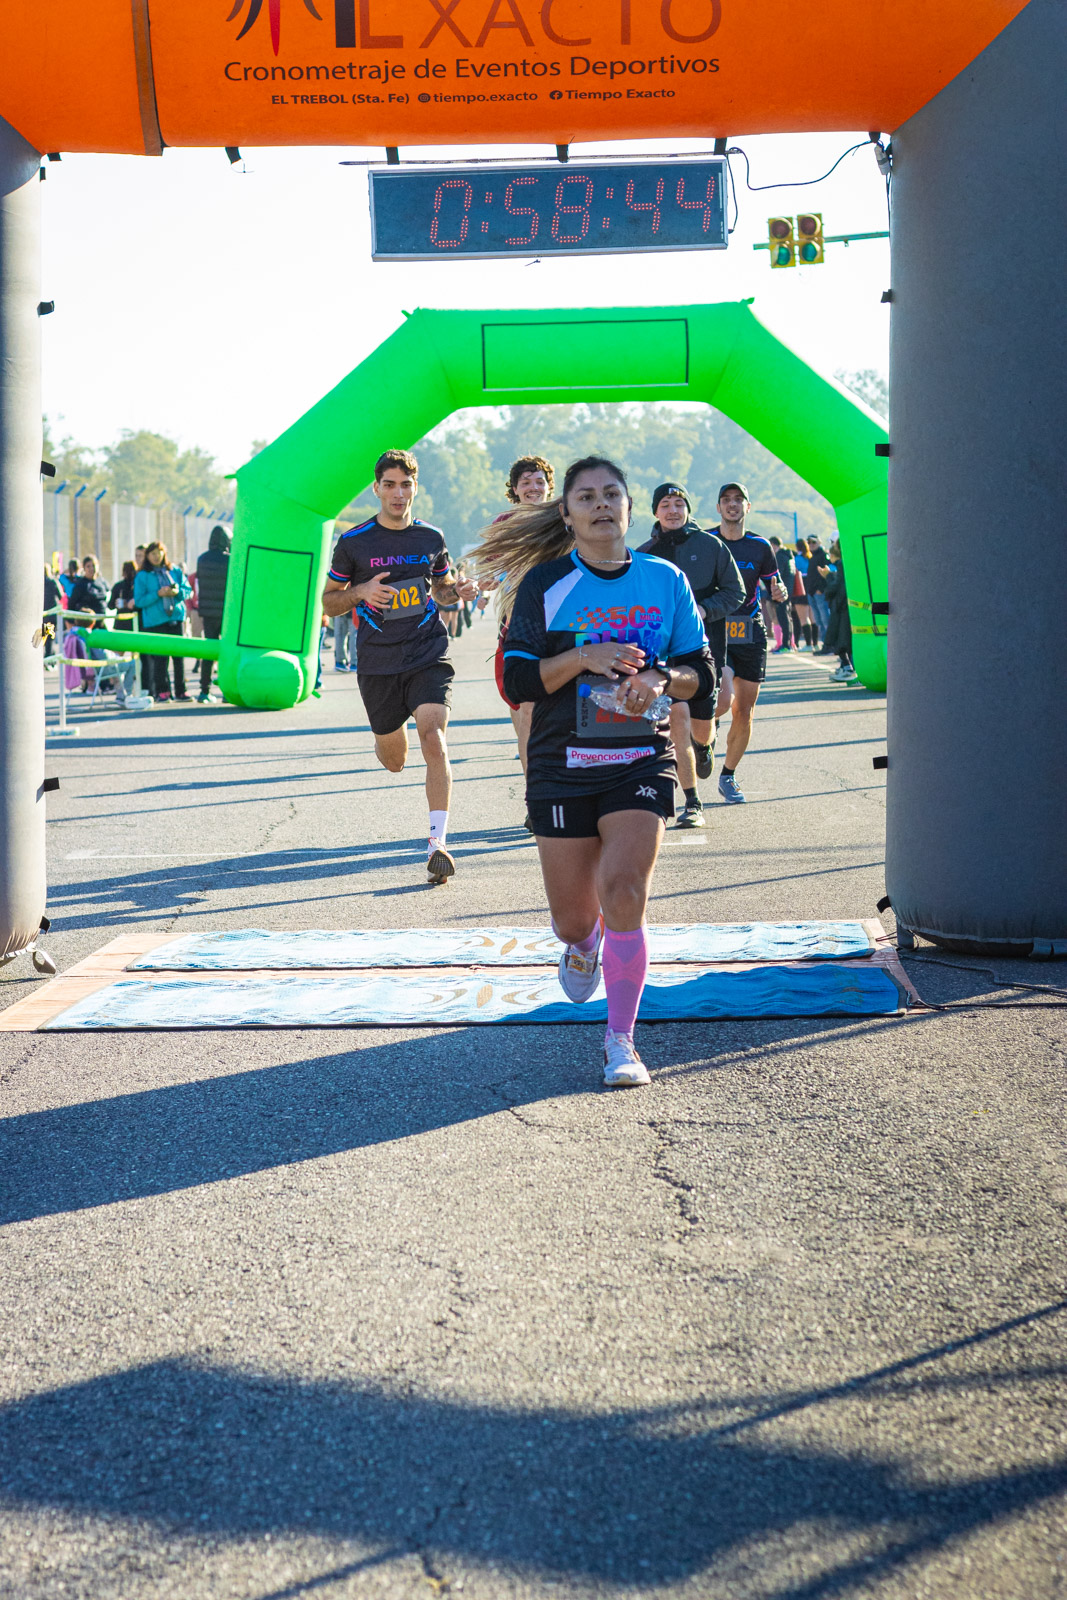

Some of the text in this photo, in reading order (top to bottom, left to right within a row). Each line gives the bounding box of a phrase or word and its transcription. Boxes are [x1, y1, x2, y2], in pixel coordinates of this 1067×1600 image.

[224, 55, 720, 84] Cronometraje de Eventos Deportivos
[271, 88, 676, 105] EL TREBOL (Sta. Fe) tiempo.exacto Tiempo Exacto
[430, 175, 716, 248] 0:58:44
[370, 554, 430, 568] RUNNEA
[571, 749, 651, 761] Prevención Salud
